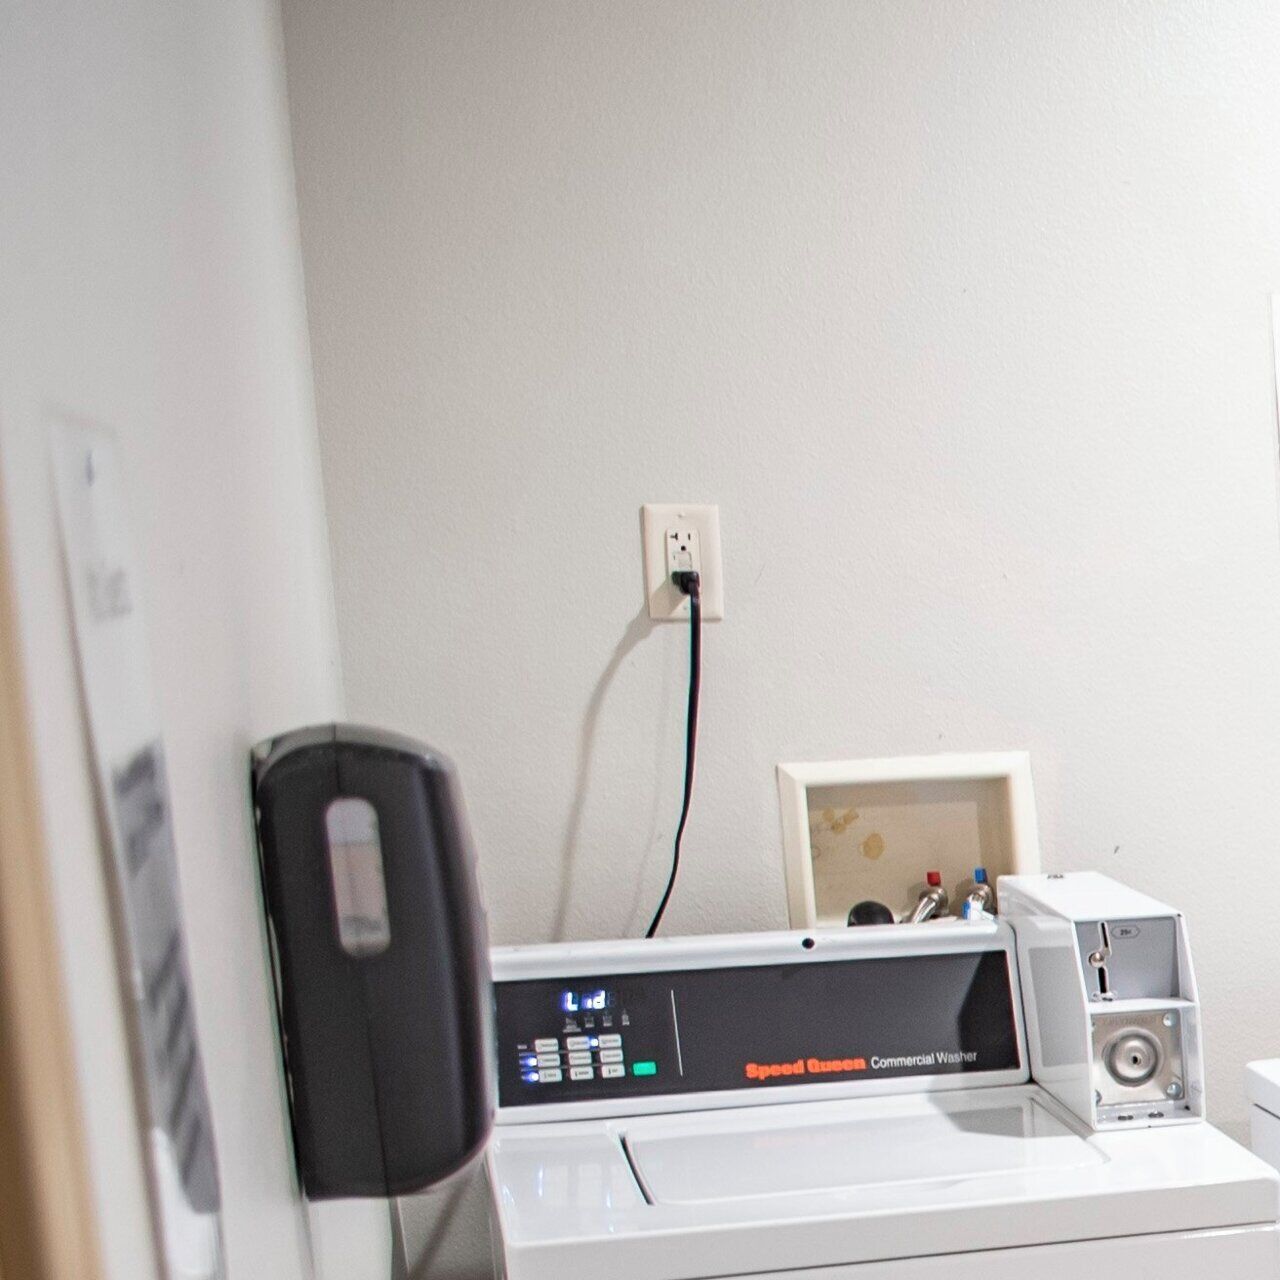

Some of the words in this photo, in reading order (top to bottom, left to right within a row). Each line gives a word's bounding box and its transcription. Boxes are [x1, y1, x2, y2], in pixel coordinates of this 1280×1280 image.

[745, 1059, 805, 1081] Speed
[806, 1056, 867, 1075] Queen
[870, 1052, 936, 1070] Commercial
[936, 1050, 979, 1066] Washer
